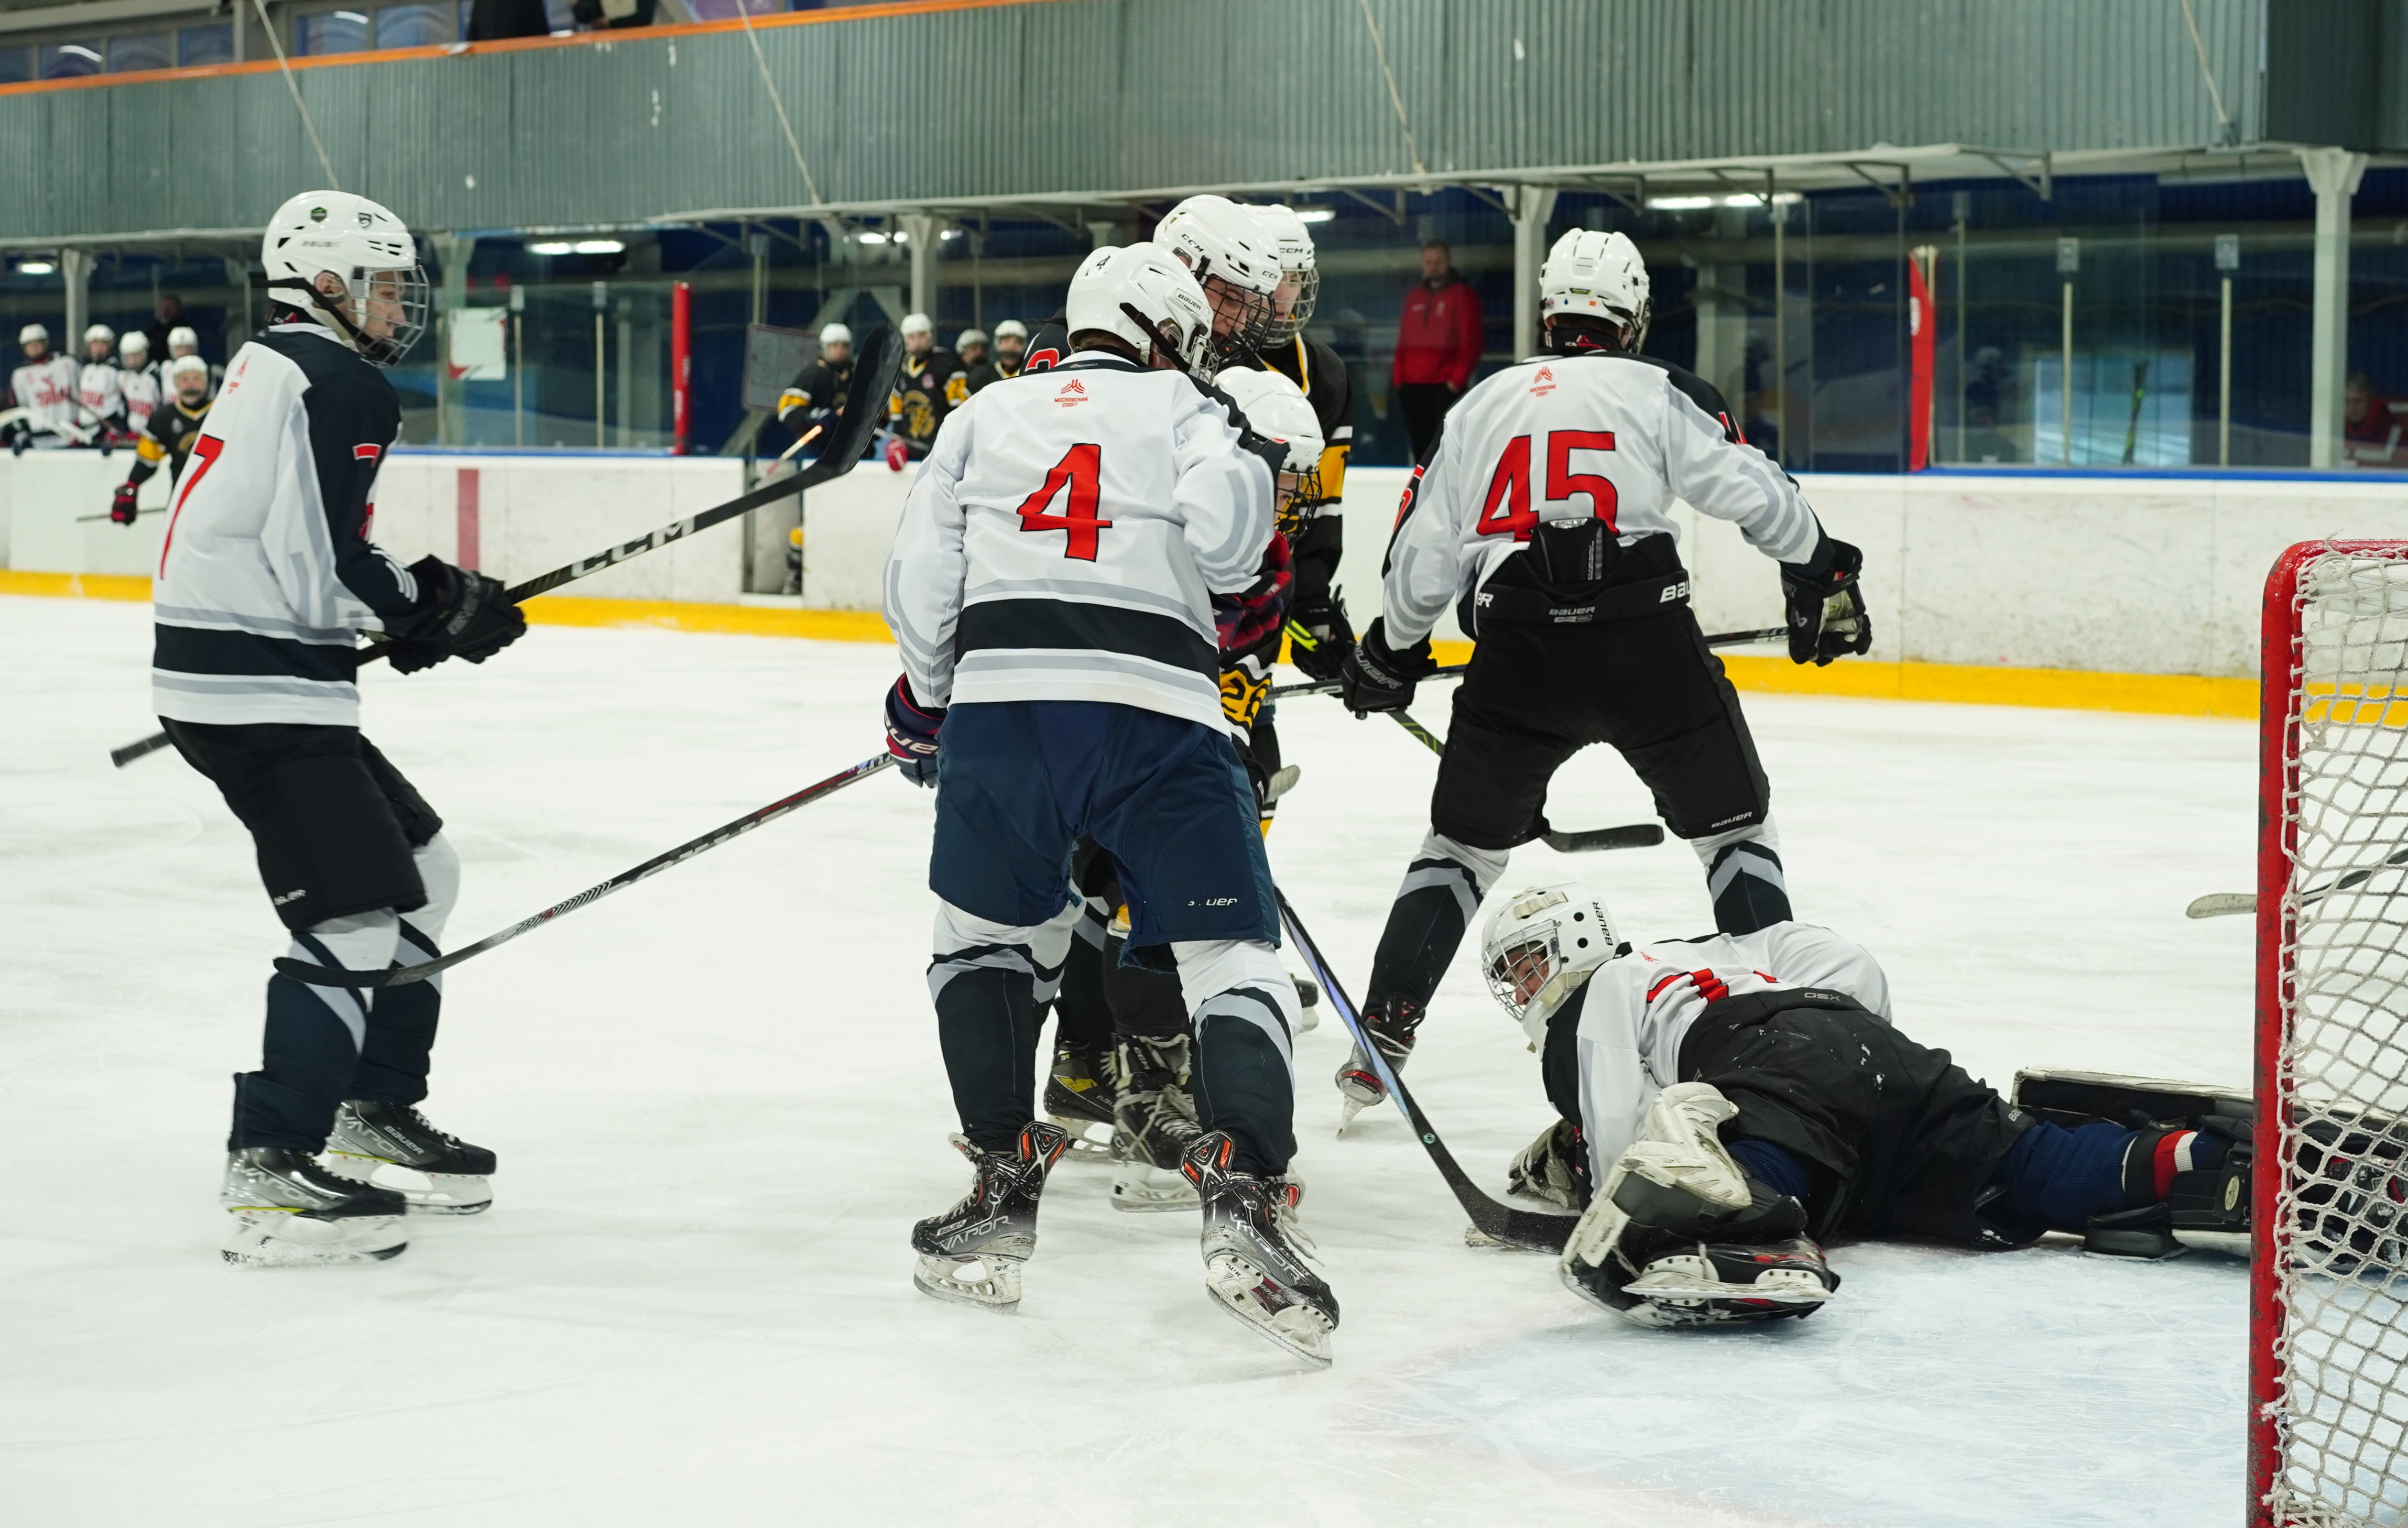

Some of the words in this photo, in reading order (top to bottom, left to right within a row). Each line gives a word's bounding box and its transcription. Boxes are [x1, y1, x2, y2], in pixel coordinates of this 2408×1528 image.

[1181, 234, 1205, 253] CCM
[1016, 442, 1113, 563] 4
[1476, 429, 1620, 543] 45
[160, 434, 224, 580] 7
[571, 515, 695, 578] CCM
[1549, 606, 1595, 616] BAUER
[1711, 811, 1752, 828] BAUER
[1592, 902, 1614, 946] BAUER
[1804, 992, 1840, 1002] GSX
[384, 1125, 424, 1155] BAUER
[938, 1215, 1016, 1251] VAPOR
